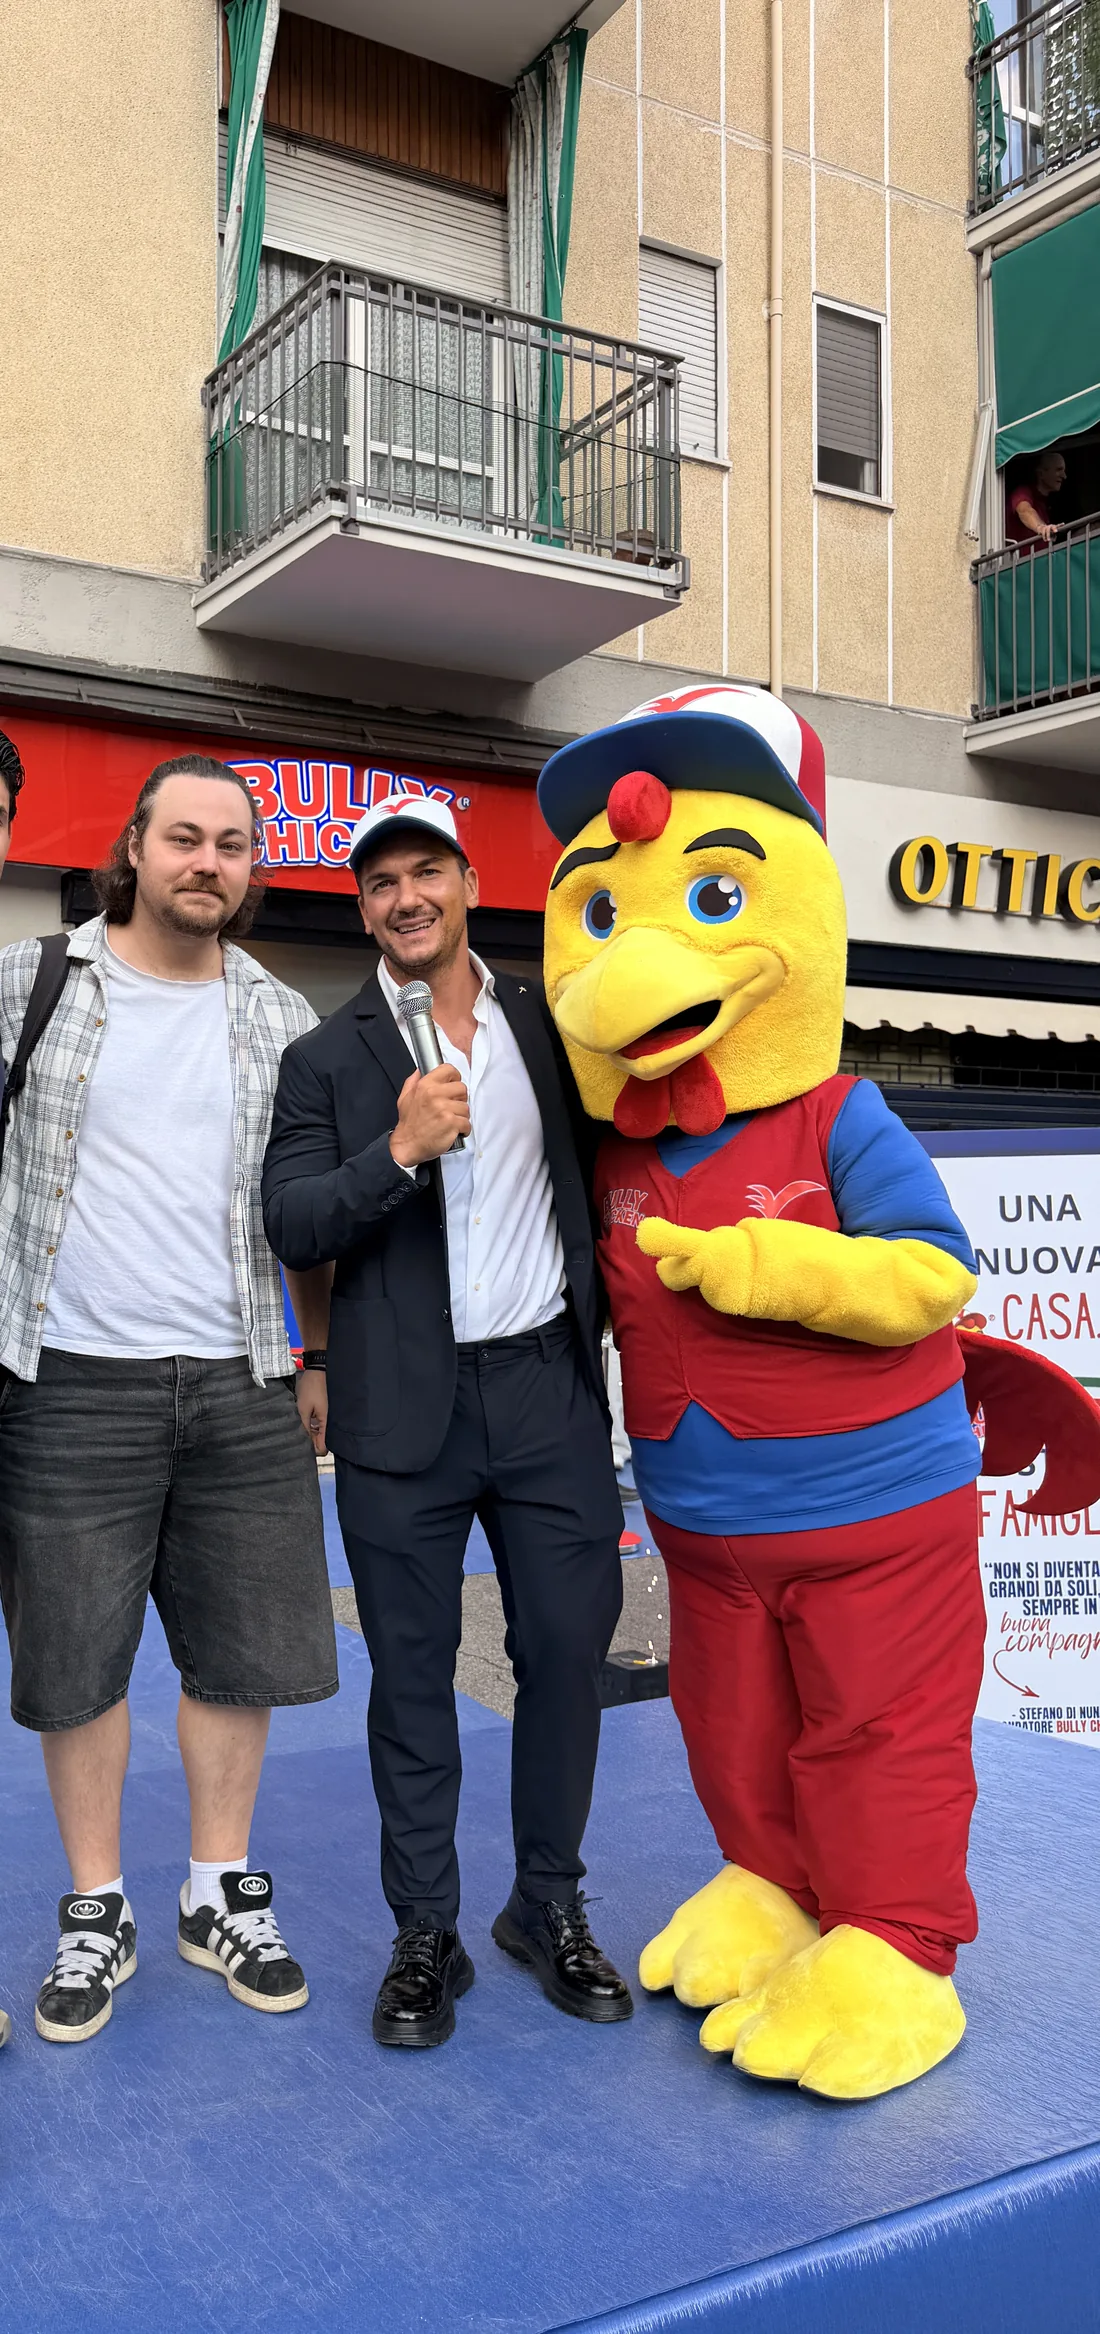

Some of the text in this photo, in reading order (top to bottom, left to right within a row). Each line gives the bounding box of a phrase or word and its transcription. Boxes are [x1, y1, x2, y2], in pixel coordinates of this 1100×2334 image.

[890, 835, 1100, 922] OTTIC
[998, 1194, 1082, 1222] UNA
[975, 1246, 1100, 1275] NUOVA
[1026, 1561, 1039, 1578] SI
[1044, 1560, 1100, 1578] DIVENTA
[989, 1580, 1040, 1598] GRANDI
[1045, 1580, 1063, 1597] DA
[1023, 1597, 1097, 1616] SEMPRE IN
[1000, 1611, 1051, 1634] buona
[1019, 1707, 1063, 1720] STEFANO
[1066, 1706, 1076, 1719] DI
[1056, 1720, 1087, 1733] BULLY
